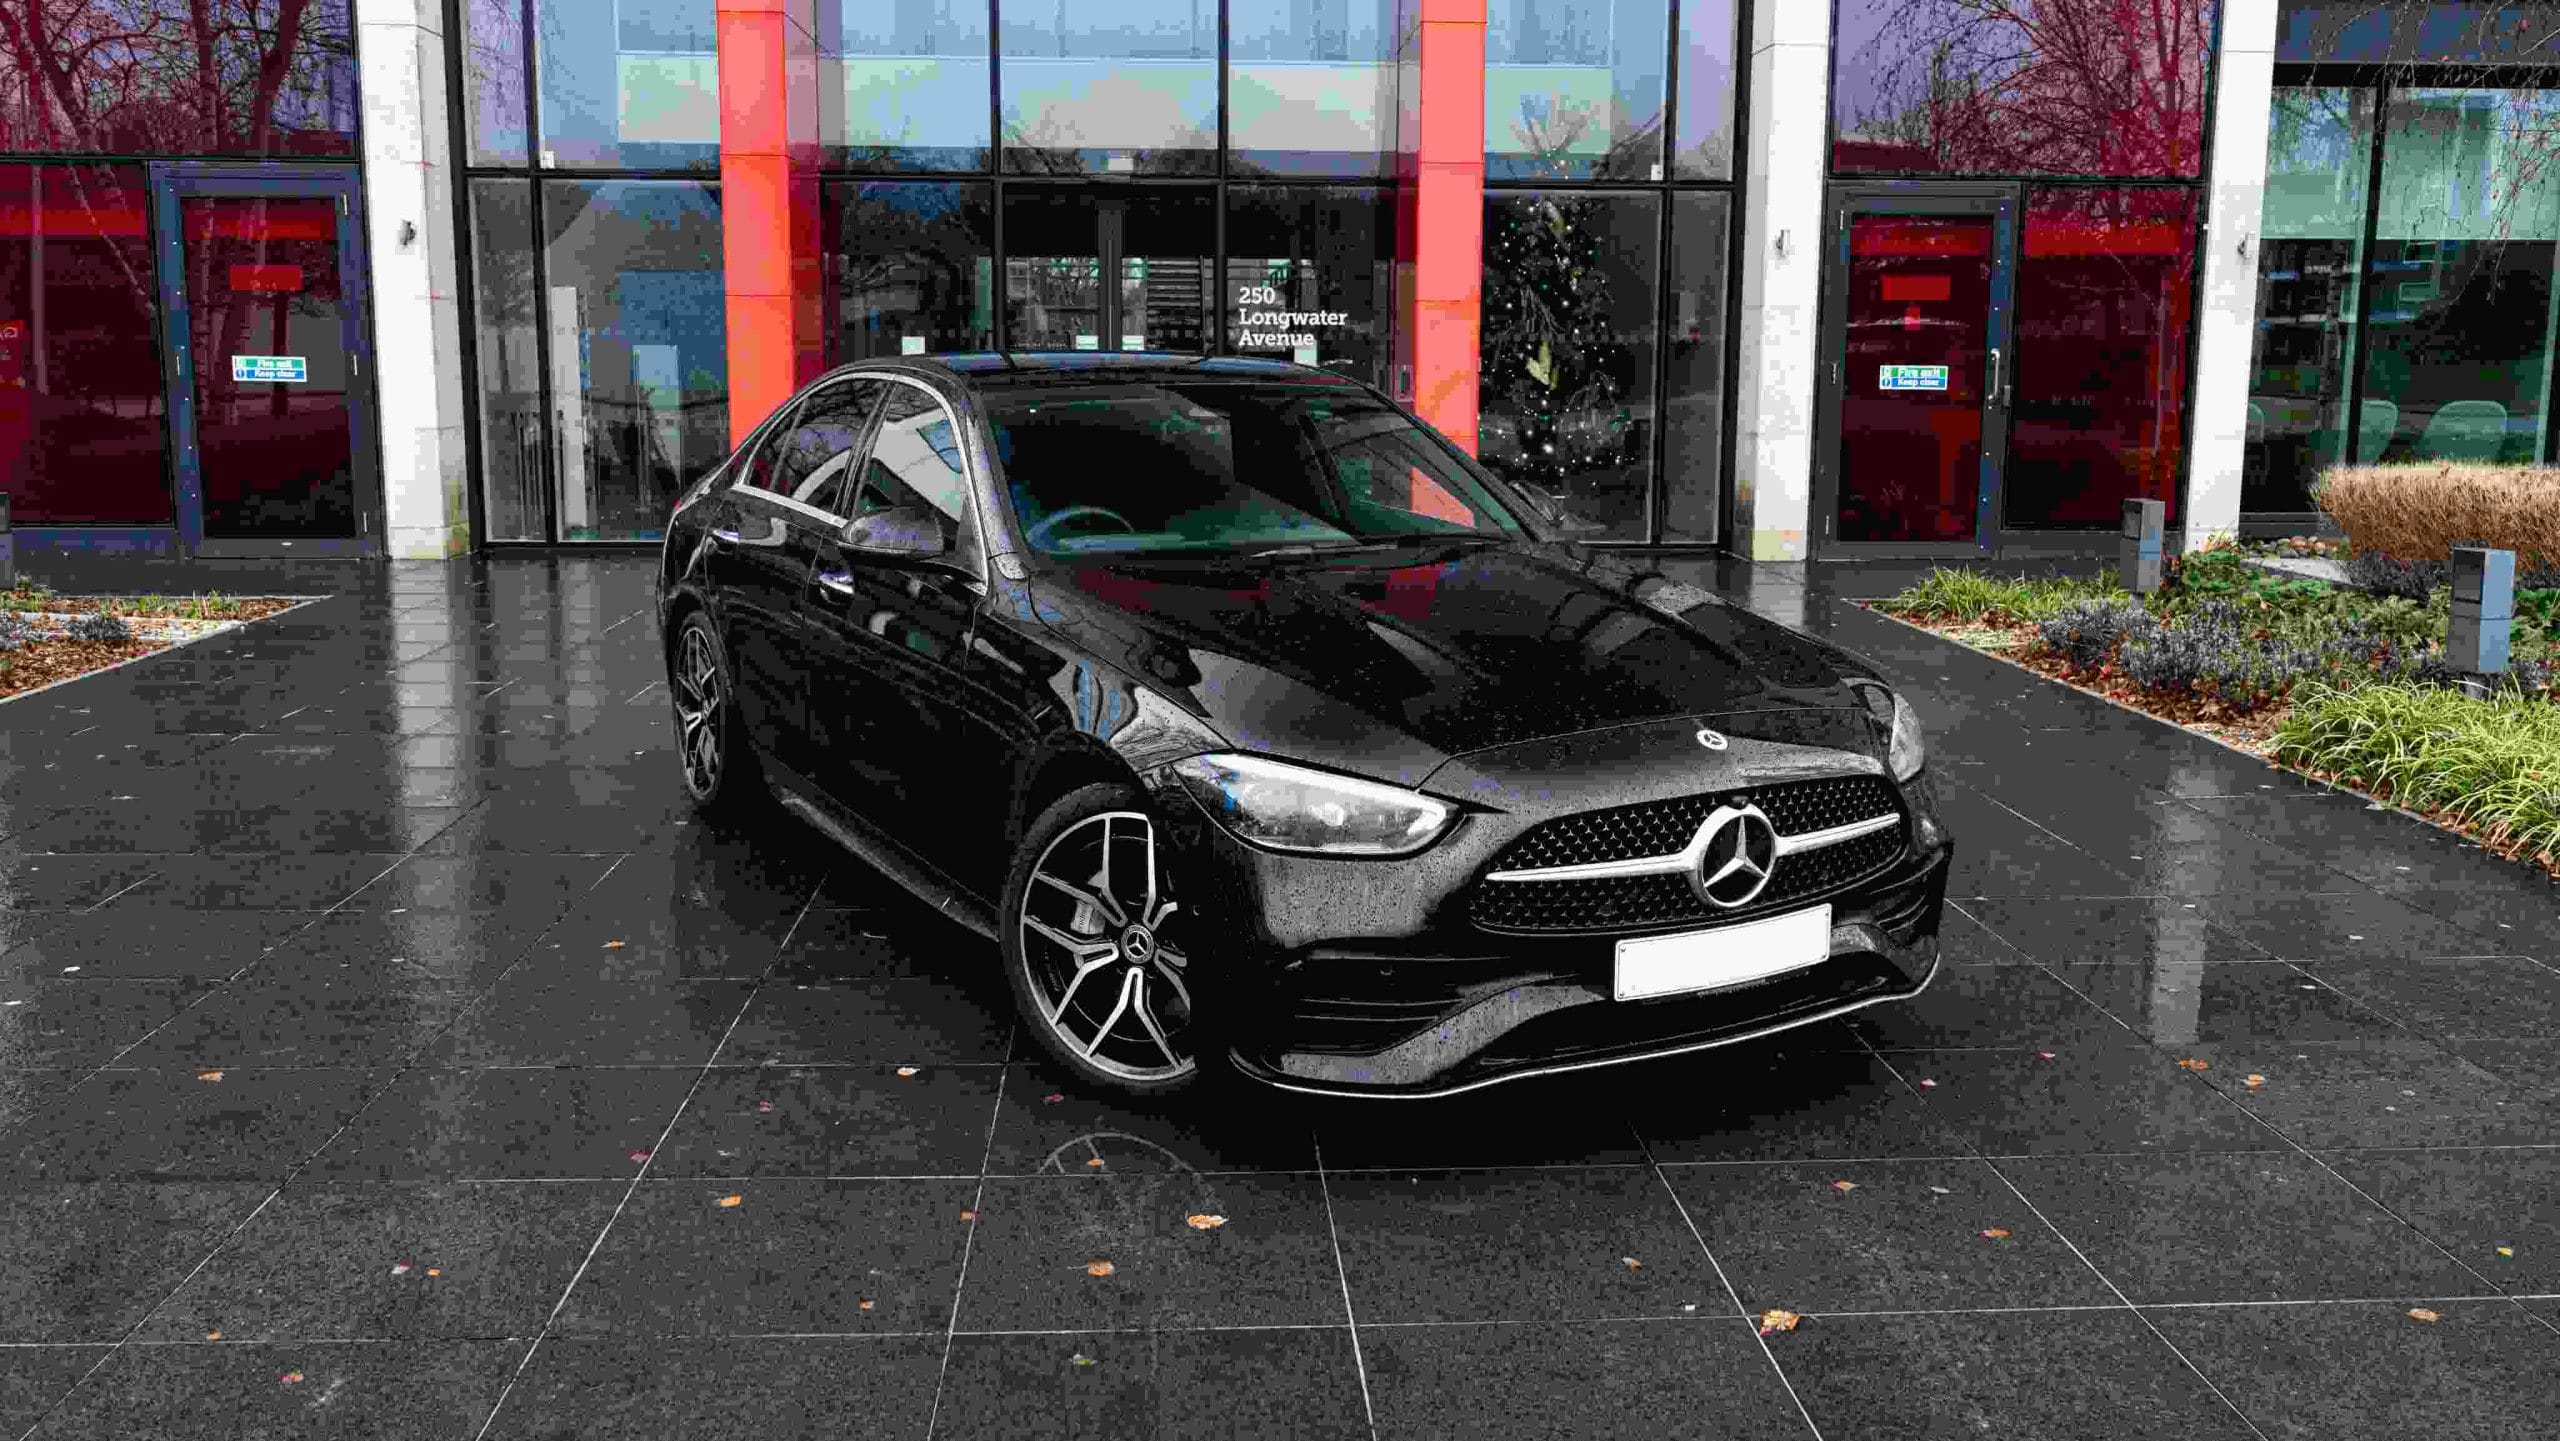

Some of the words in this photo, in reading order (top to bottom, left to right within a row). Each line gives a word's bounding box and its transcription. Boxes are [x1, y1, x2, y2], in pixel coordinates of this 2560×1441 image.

[1239, 287, 1276, 304] 250
[1239, 308, 1348, 330] Longwater
[1238, 328, 1314, 346] Avenue
